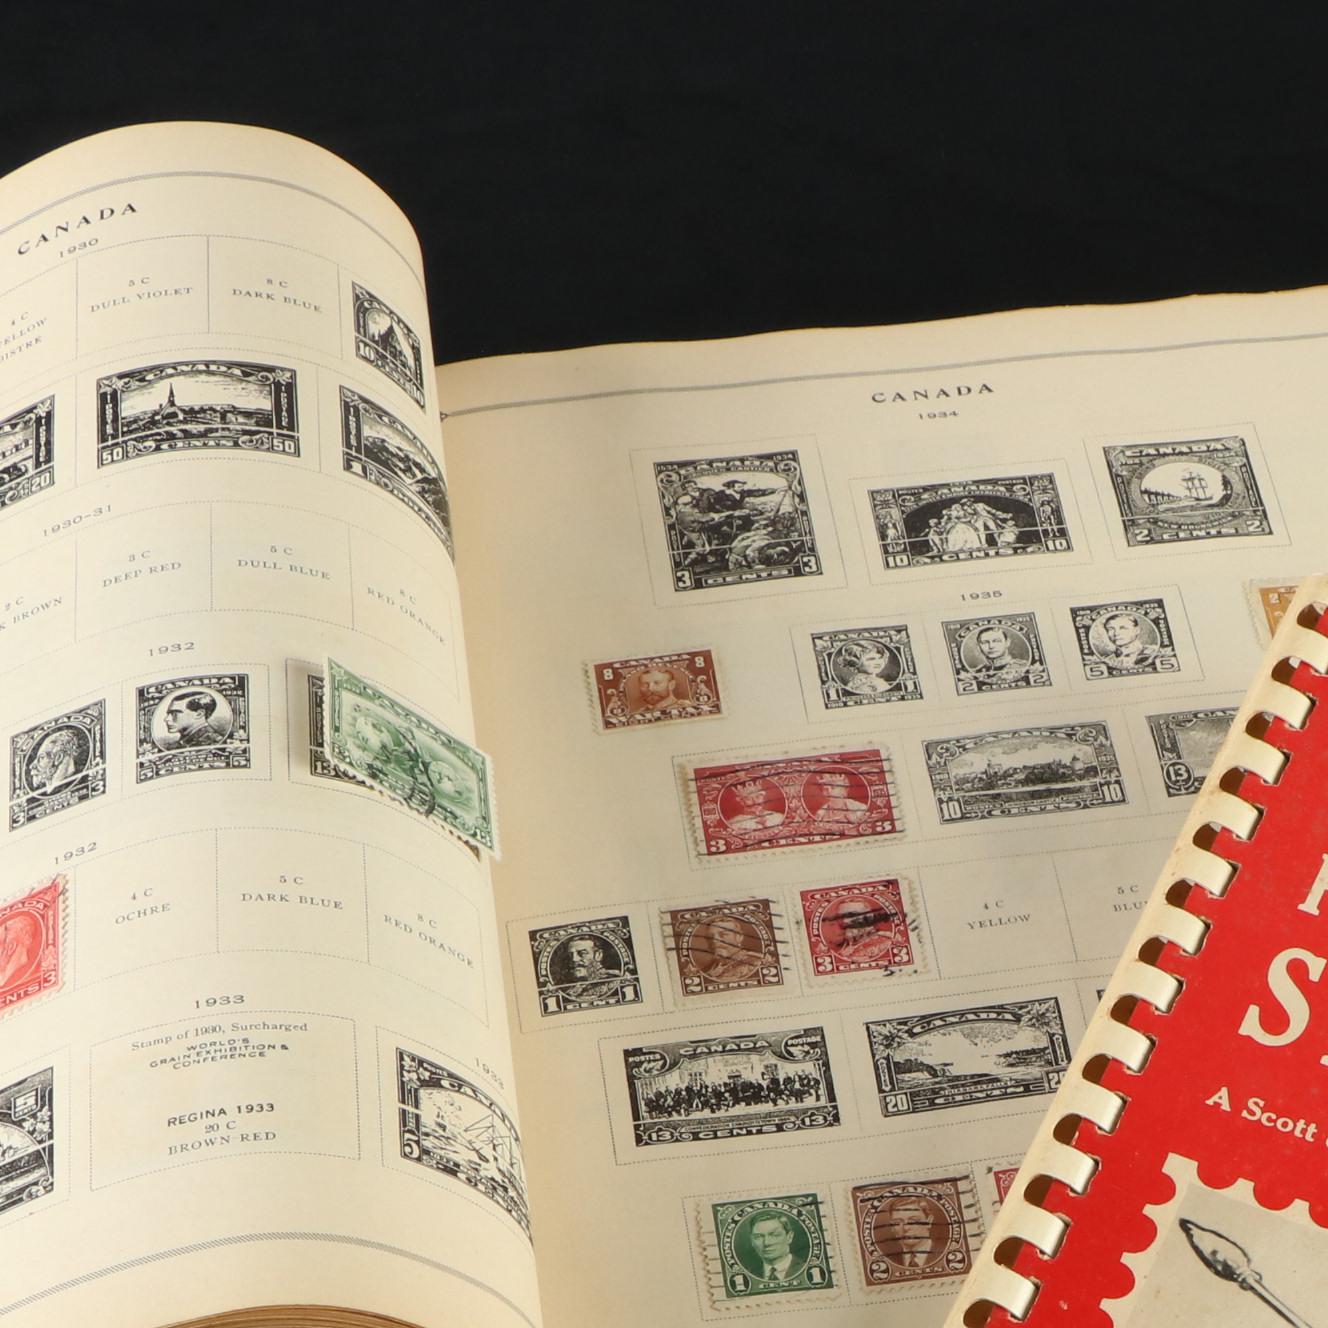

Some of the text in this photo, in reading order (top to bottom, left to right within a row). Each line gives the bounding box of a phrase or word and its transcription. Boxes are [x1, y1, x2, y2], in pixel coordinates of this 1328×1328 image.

[17, 202, 138, 256] CANADA
[59, 237, 100, 258] 1930
[141, 276, 151, 285] C
[278, 280, 289, 289] C
[90, 286, 194, 313] DULL VIOLET
[231, 287, 323, 314] DARK BLUE
[0, 317, 48, 348] ELLOW
[358, 341, 375, 361] 10
[144, 363, 244, 381] CANADA
[871, 382, 995, 404] CANADA
[918, 410, 959, 421] 1934
[102, 437, 296, 465] 50 50
[1125, 440, 1233, 457] CANADA
[681, 460, 775, 475] CANADA
[31, 472, 51, 492] 20
[920, 483, 1004, 500] CANADA
[43, 504, 112, 537] 1930-31
[1134, 519, 1264, 542] 2 CENTS 2
[283, 546, 294, 556] C
[886, 539, 1067, 568] 10 CENTS 10
[103, 560, 182, 588] DEEP RED
[237, 557, 331, 581] DULL BLUE
[676, 554, 817, 590] 3 CENTS 3
[961, 590, 1003, 601] 1935
[13, 596, 64, 625] BROWN
[1091, 604, 1146, 620] CANADA
[960, 619, 1021, 636] CANADA
[148, 640, 196, 658] 1932
[603, 656, 705, 681] 8 8
[1089, 658, 1175, 678] 5 5
[148, 676, 235, 697] CANADA
[962, 674, 1044, 692] 2 2
[1168, 764, 1189, 781] 13
[12, 780, 105, 828] 3 3
[940, 800, 962, 820] 10
[1101, 783, 1124, 802] 10
[709, 820, 893, 853] 3 3
[54, 841, 98, 865] 1932
[279, 874, 304, 886] 5 C
[1129, 885, 1139, 894] C
[143, 887, 154, 897] C
[241, 891, 344, 911] DARK BLUE
[114, 902, 172, 925] OCHRE
[995, 900, 1005, 909] C
[967, 913, 1032, 931] YELLOW
[383, 913, 476, 970] RED ORANGE
[815, 946, 910, 973] 3 3
[43, 970, 57, 988] 3
[684, 966, 779, 994] 2 2
[195, 993, 246, 1009] 1933
[911, 1011, 1017, 1034] CANADA
[131, 1035, 173, 1052] Stamp
[176, 1029, 190, 1040] of
[230, 1020, 309, 1033] Surcharged
[186, 1036, 250, 1052] WORLD'S
[787, 1035, 822, 1046] POSTAGE
[149, 1053, 192, 1069] GRAIN
[196, 1043, 276, 1058] EXHIBITION
[628, 1053, 661, 1063] POSTES
[678, 1040, 770, 1056] CANADA
[172, 1050, 267, 1071] CONFERENCE
[885, 1094, 909, 1112] 20
[933, 1085, 1025, 1105] CENTS
[167, 1102, 275, 1128] REGINA 1933
[1204, 1086, 1231, 1112] A
[1242, 1097, 1318, 1142] Scott
[226, 1120, 237, 1130] C
[650, 1131, 672, 1142] 13
[698, 1125, 778, 1139] CENTS
[803, 1114, 825, 1127] 13
[168, 1131, 277, 1156] BROWN RED
[403, 1132, 420, 1160] 5
[872, 1186, 940, 1208] CANADA
[733, 1201, 800, 1221] CANADA
[870, 1251, 965, 1281] 2 2
[733, 1266, 824, 1292] 1 1
